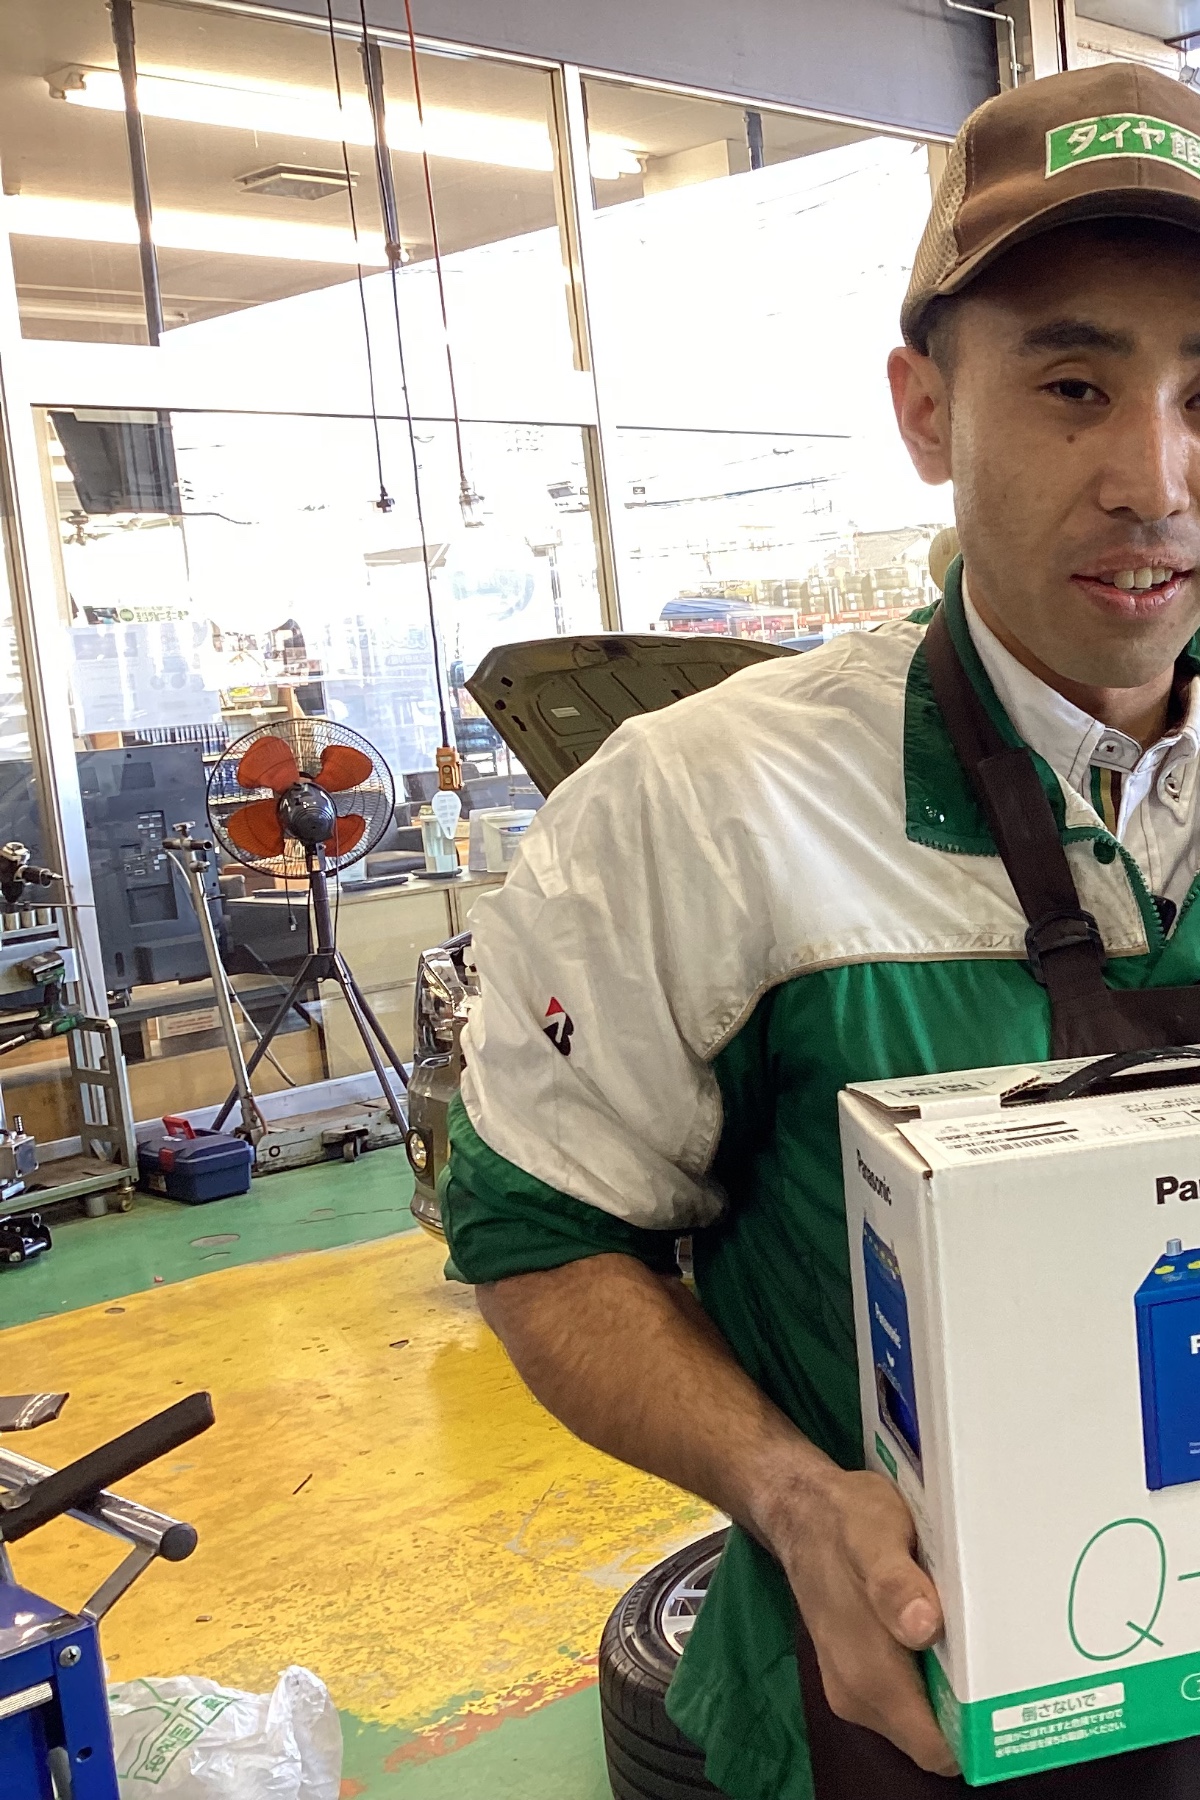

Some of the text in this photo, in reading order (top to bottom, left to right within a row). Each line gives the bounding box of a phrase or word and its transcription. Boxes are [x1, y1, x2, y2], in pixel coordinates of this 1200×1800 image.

[1022, 1693, 1097, 1723] 倒さないで
